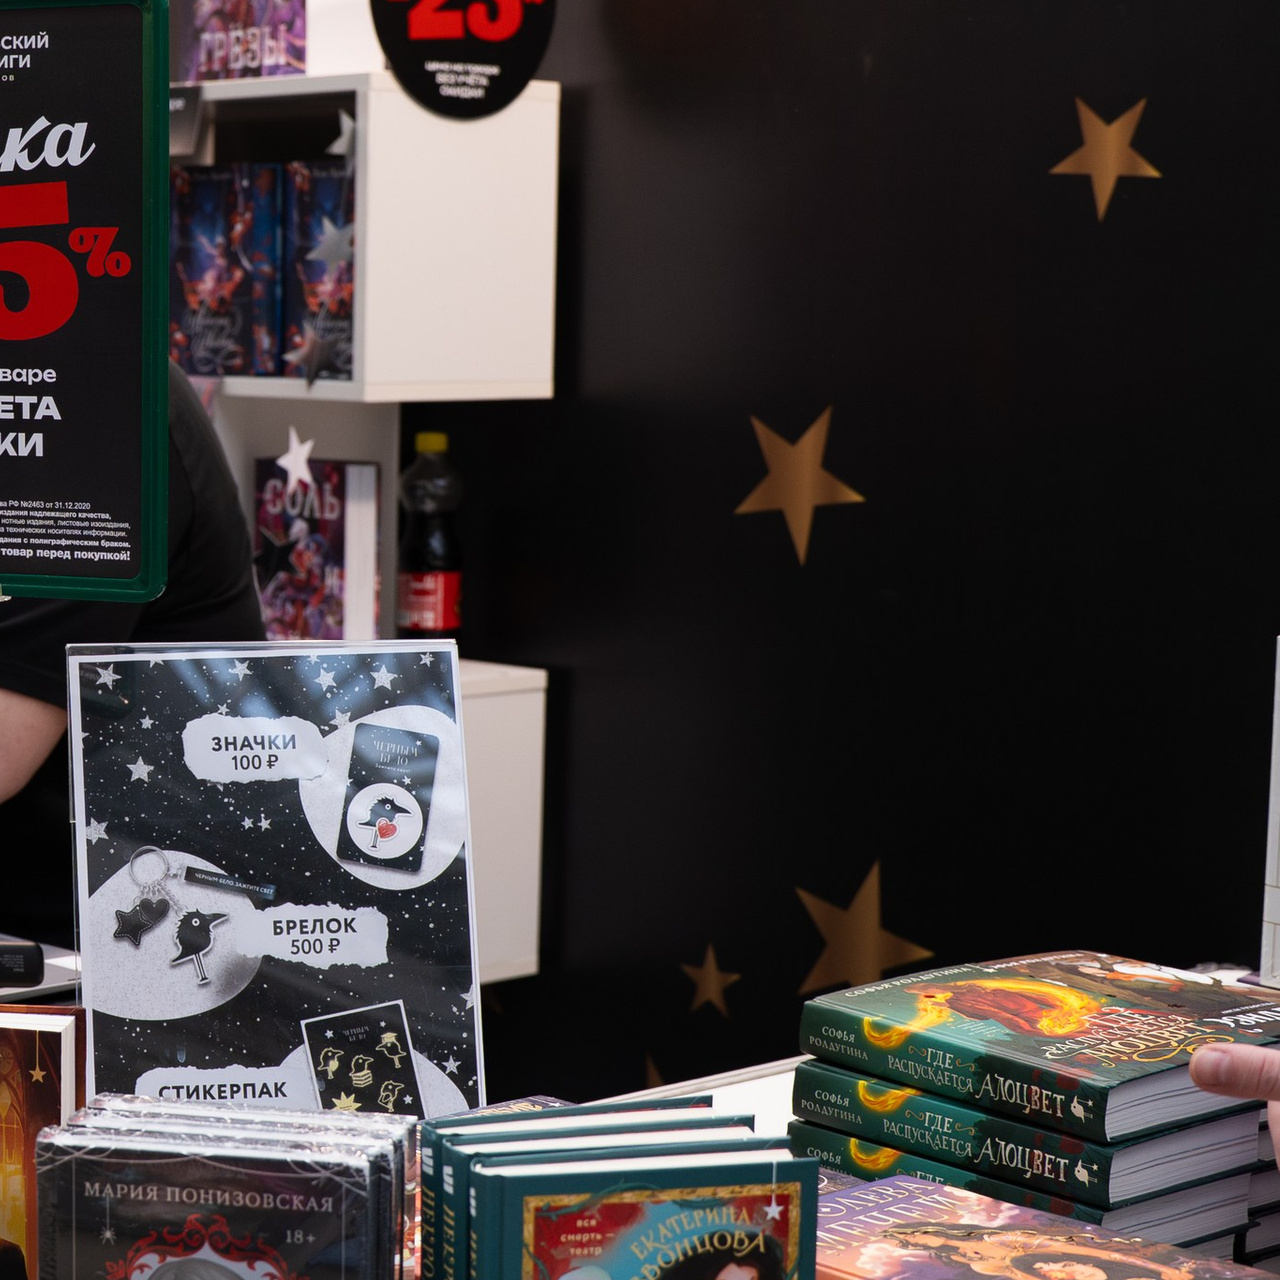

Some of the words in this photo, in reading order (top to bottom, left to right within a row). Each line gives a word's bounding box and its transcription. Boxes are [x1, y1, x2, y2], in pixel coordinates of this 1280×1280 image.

[199, 21, 287, 71] ГРЁЗЫ
[0, 546, 34, 558] товар
[36, 547, 72, 560] перед
[74, 547, 130, 562] покупкой!
[211, 734, 297, 752] ЗНАЧКИ
[231, 755, 262, 770] 100
[266, 754, 279, 769] ₽
[272, 917, 357, 936] БРЕЛОК
[290, 939, 325, 954] 500
[328, 938, 340, 954] ₽
[822, 1026, 856, 1043] СОФЬЯ
[809, 1036, 869, 1061] РОЛДУГИНА
[926, 1047, 954, 1069] ГДЕ
[887, 1054, 974, 1093] РАСПУСКАЕТСЯ
[158, 1081, 288, 1100] СТИКЕРПАК
[814, 1089, 850, 1108] СОФЬЯ
[975, 1073, 1065, 1118] АЛОЦВЕТ
[801, 1099, 863, 1125] РОЛДУГИНА
[924, 1111, 953, 1133] ГДЕ
[883, 1119, 973, 1158] РАСПУСКАЕТСЯ
[807, 1146, 842, 1165] СОФЬЯ
[974, 1137, 1069, 1183] АЛОЦВЕТ
[83, 1181, 159, 1202] МАРИЯ
[166, 1186, 335, 1213] ПОНИЗОВСКАЯ
[285, 1229, 316, 1244] 18+
[630, 1206, 751, 1260] ЕКАТЕРИНА
